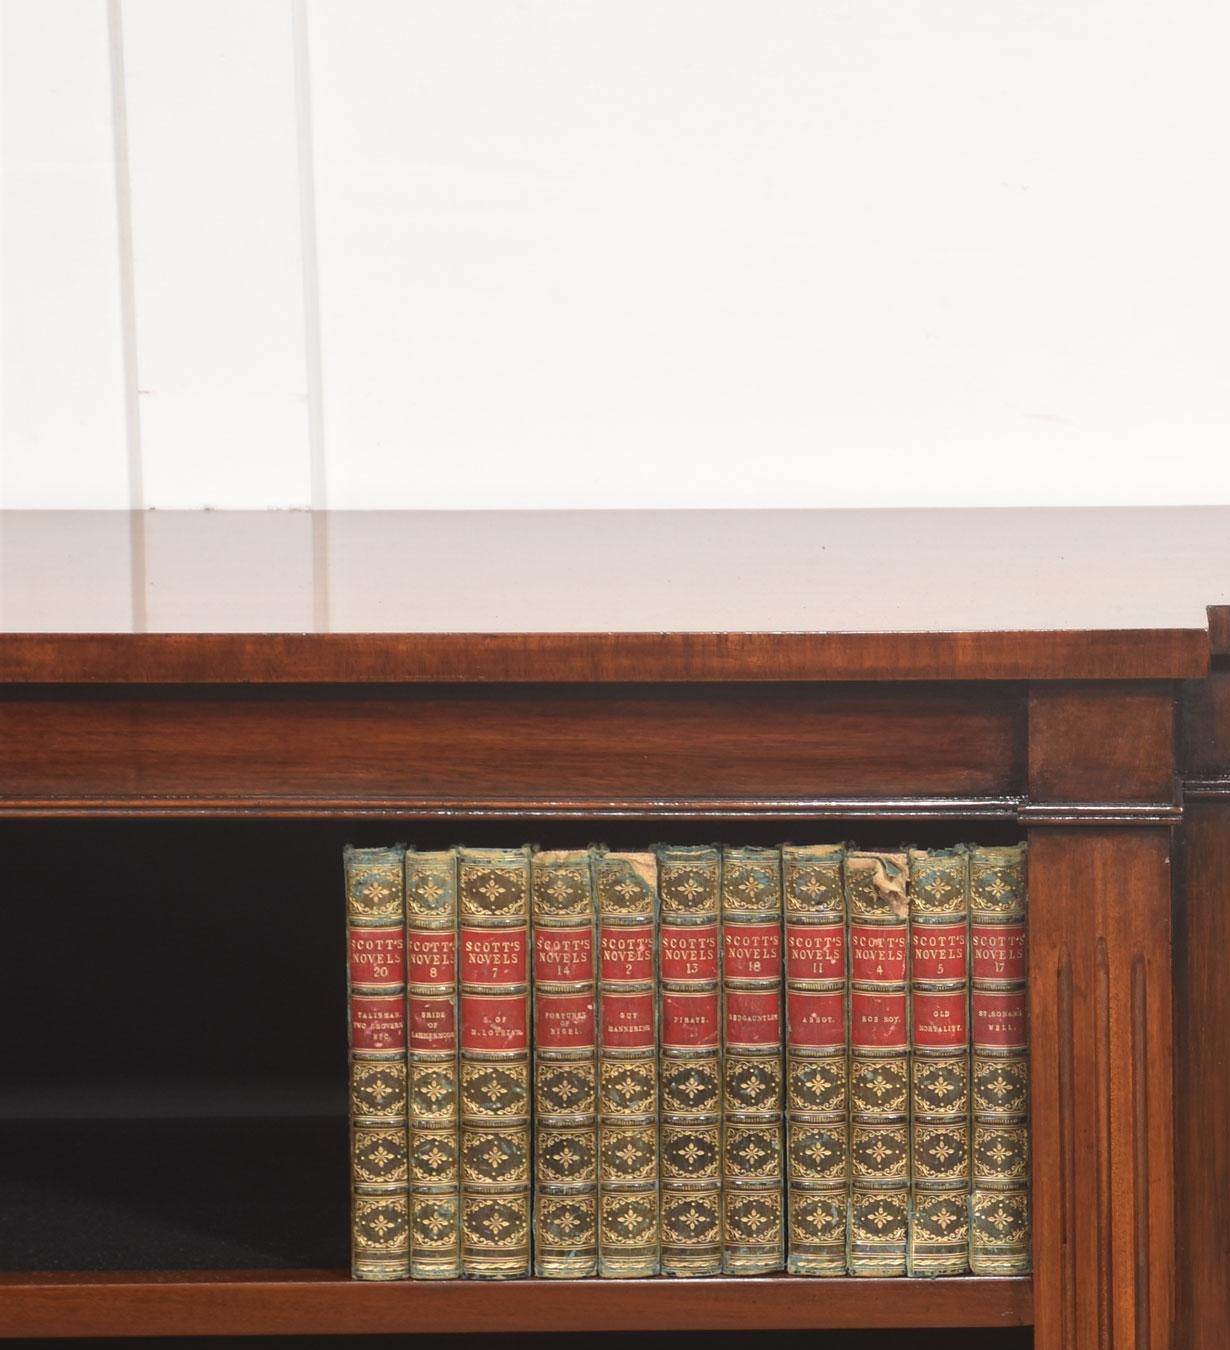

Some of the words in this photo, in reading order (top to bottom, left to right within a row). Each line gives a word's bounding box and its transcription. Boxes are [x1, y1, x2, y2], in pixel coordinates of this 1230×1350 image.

[352, 939, 403, 951] SCOTT'S
[465, 941, 520, 953] SCOTT'S
[537, 938, 590, 951] SCOTT'S
[602, 938, 654, 950] SCOTT'S
[663, 938, 715, 949] SCOTT'S
[726, 936, 779, 947] SCOTT'S
[789, 937, 842, 948] SCOTT'S
[853, 936, 905, 948] SCOTT'S
[913, 936, 965, 947] SCOTT'S
[973, 936, 1024, 947] SCOTT'S
[353, 952, 401, 964] NOVELS
[468, 953, 518, 965] NOVELS
[539, 951, 587, 964] NOVELS
[604, 950, 651, 962] NOVELS
[666, 950, 714, 961] NOVELS
[729, 949, 777, 960] NOVELS
[792, 949, 840, 961] NOVELS
[855, 950, 903, 961] NOVELS
[915, 949, 963, 960] NOVELS
[975, 949, 1023, 961] NOVELS
[373, 966, 388, 977] 20
[557, 965, 571, 976] 14
[626, 963, 633, 975] 2
[686, 963, 699, 974] 13
[749, 961, 761, 972] 18
[813, 963, 823, 974] 11
[876, 965, 883, 976] 4
[936, 963, 944, 975] 5
[995, 962, 1005, 973] 17
[430, 967, 437, 978] 8
[492, 968, 498, 979] 7
[494, 1014, 507, 1024] OF
[861, 1015, 879, 1023] ROB
[933, 1010, 951, 1018] OLD
[559, 1019, 570, 1027] OF
